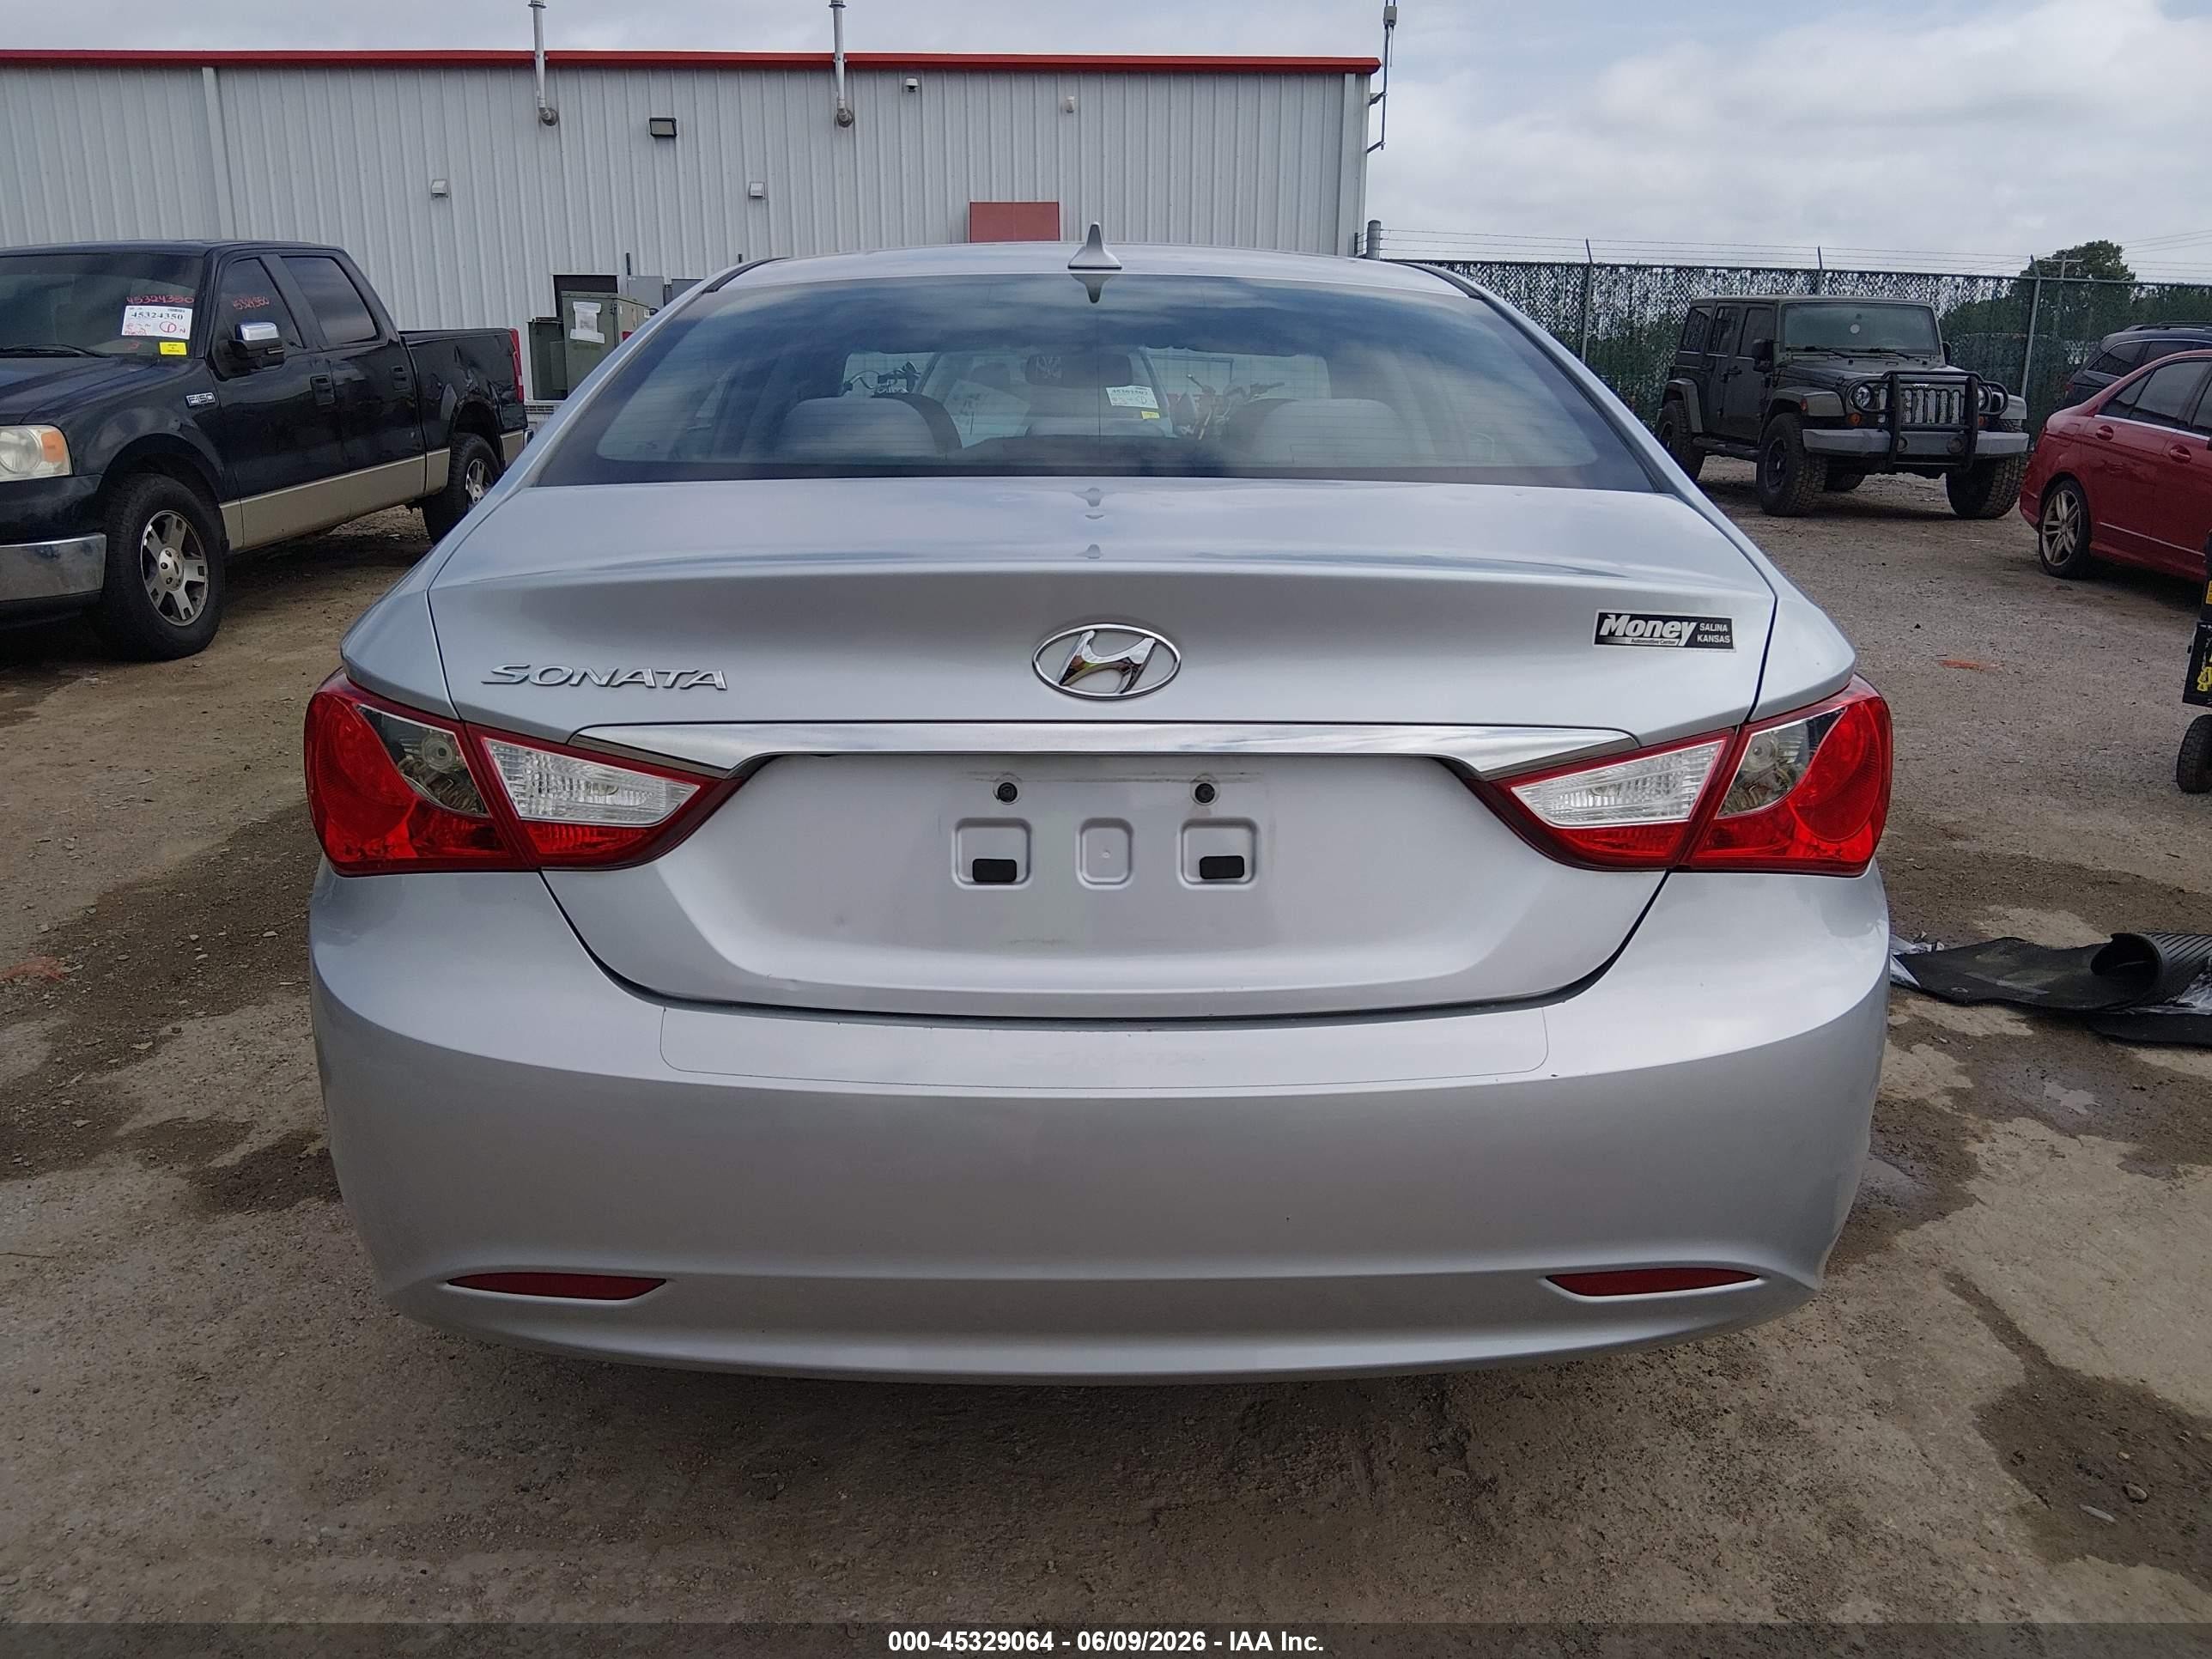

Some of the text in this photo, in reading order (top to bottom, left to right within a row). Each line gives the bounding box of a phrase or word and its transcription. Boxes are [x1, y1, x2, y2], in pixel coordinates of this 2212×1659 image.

[131, 312, 184, 320] 45324350
[1599, 614, 1698, 647] Money
[1699, 623, 1728, 632] SALINA
[1697, 635, 1731, 644] KANSAS
[481, 665, 728, 690] SONATA
